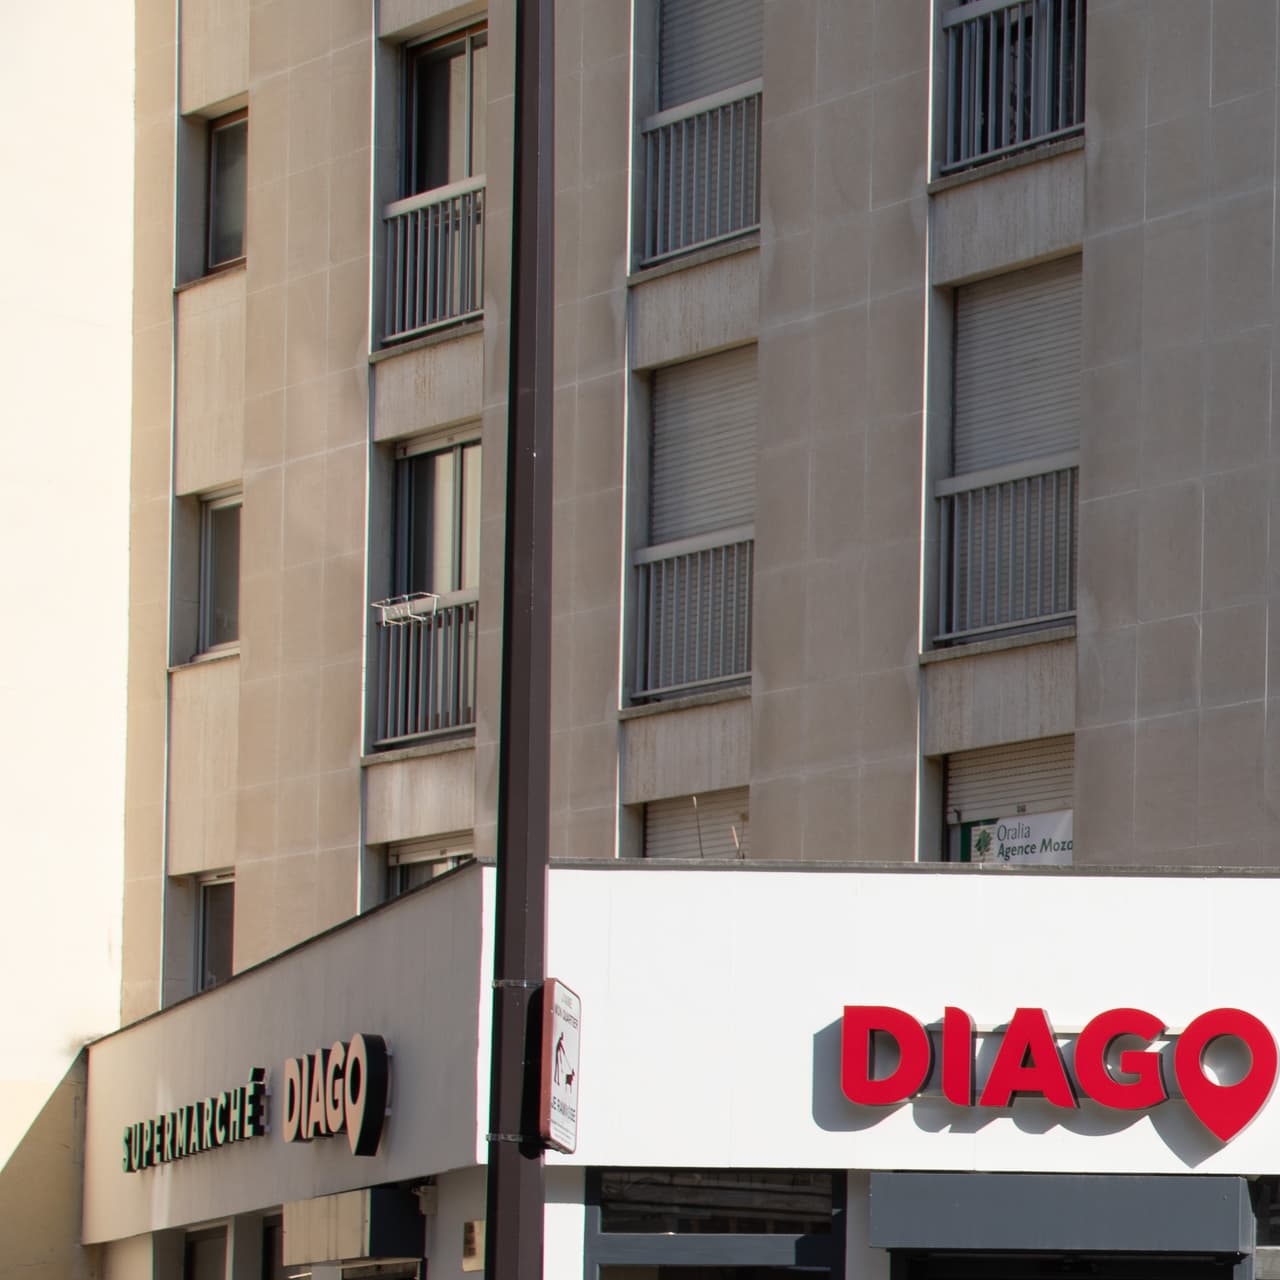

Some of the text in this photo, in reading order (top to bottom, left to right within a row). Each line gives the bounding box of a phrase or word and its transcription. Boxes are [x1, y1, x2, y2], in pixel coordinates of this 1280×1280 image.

[997, 822, 1031, 841] Oralia
[997, 842, 1037, 861] Agence
[122, 1032, 387, 1173] SUPERMARCHÉ DIAGO
[840, 1004, 1279, 1143] DIAGO
